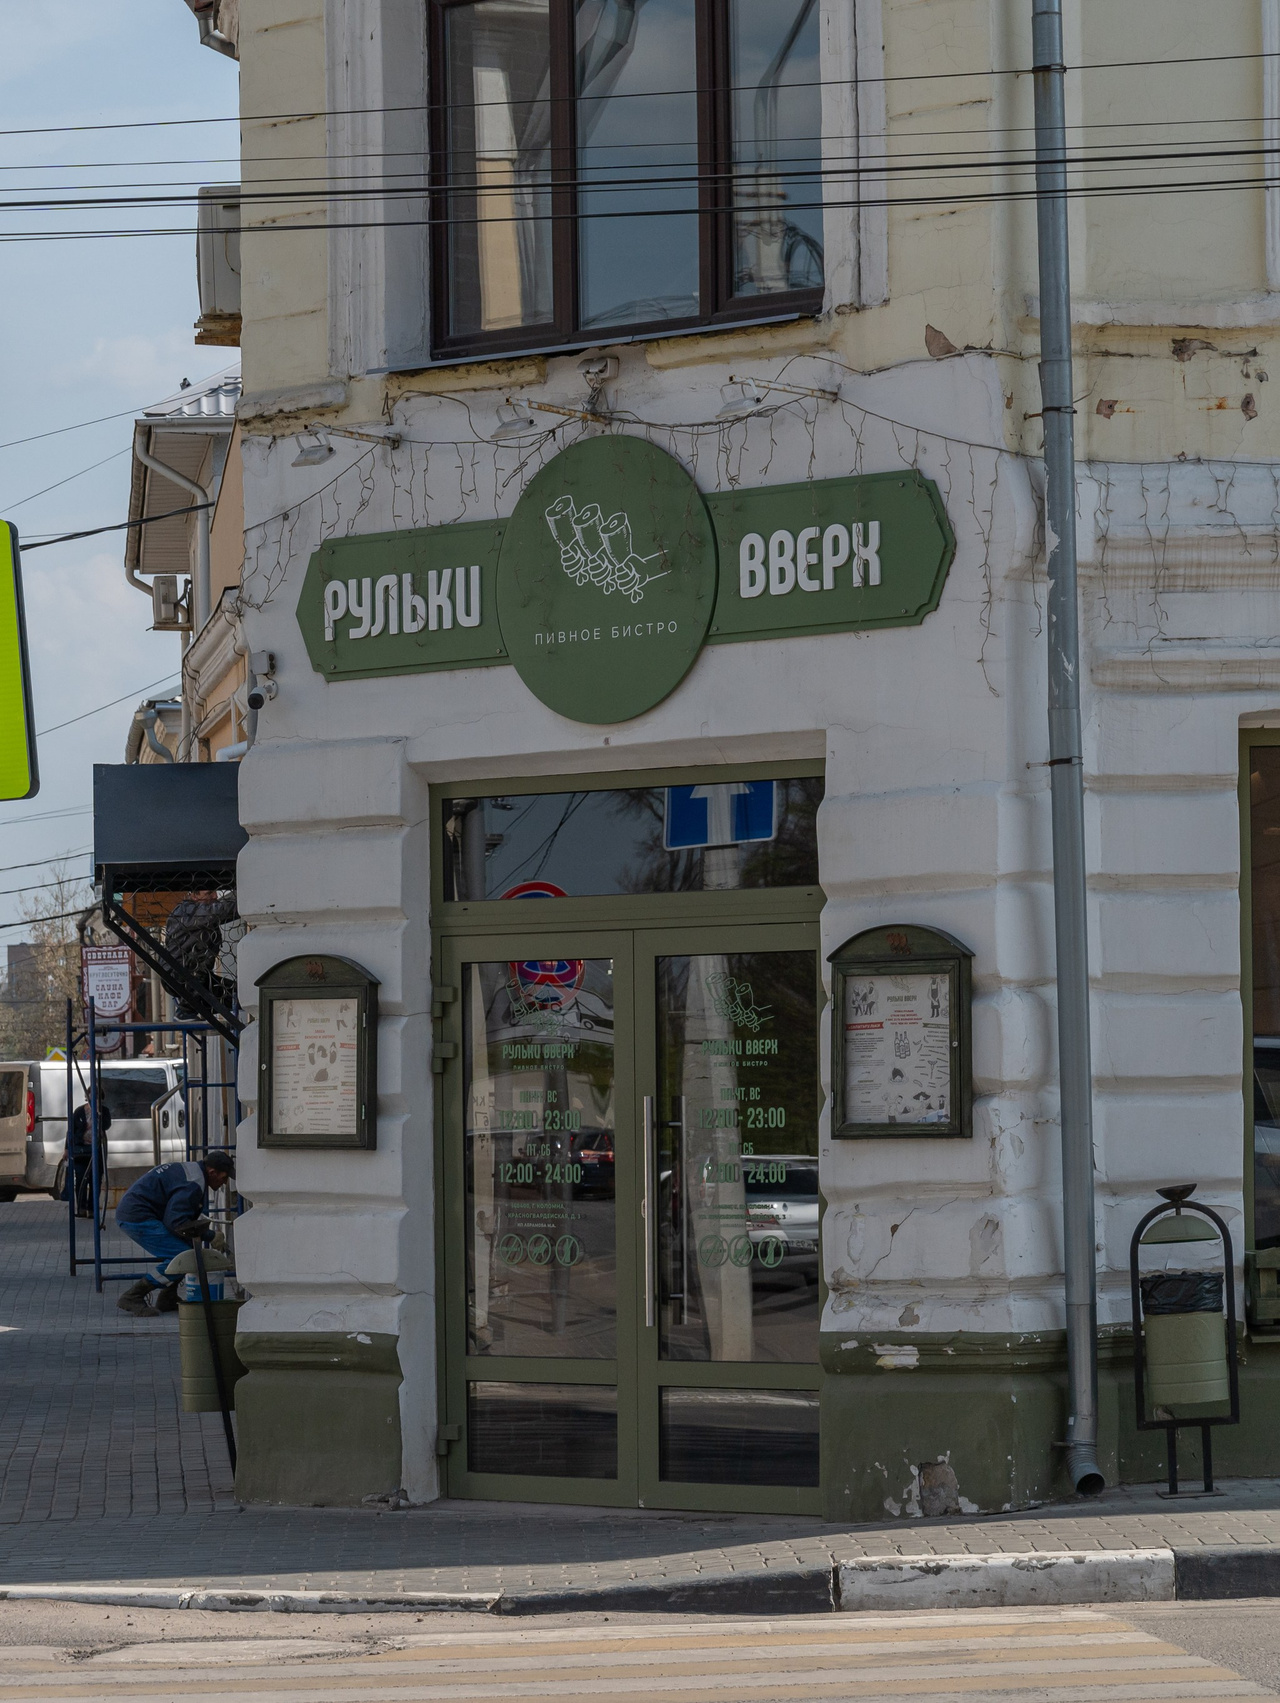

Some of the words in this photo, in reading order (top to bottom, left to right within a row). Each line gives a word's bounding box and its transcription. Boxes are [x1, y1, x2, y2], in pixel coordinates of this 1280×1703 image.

[324, 565, 483, 640] РУЛЬКИ
[739, 520, 882, 598] ВВЕРХ
[534, 628, 602, 645] ПИВНОЕ
[611, 620, 678, 639] БИСТРО
[502, 1044, 541, 1059] РУЛЬКИ
[543, 1044, 574, 1058] ВВЕРХ
[746, 1039, 778, 1054] ВВЕРХ
[547, 1090, 558, 1102] ВС
[750, 1087, 761, 1100] ВС
[545, 1110, 580, 1130] 23:00
[747, 1107, 786, 1128] 23:00
[541, 1144, 550, 1156] СБ
[743, 1143, 754, 1154] СБ
[499, 1163, 533, 1183] 12:00
[545, 1163, 581, 1184] 24:00
